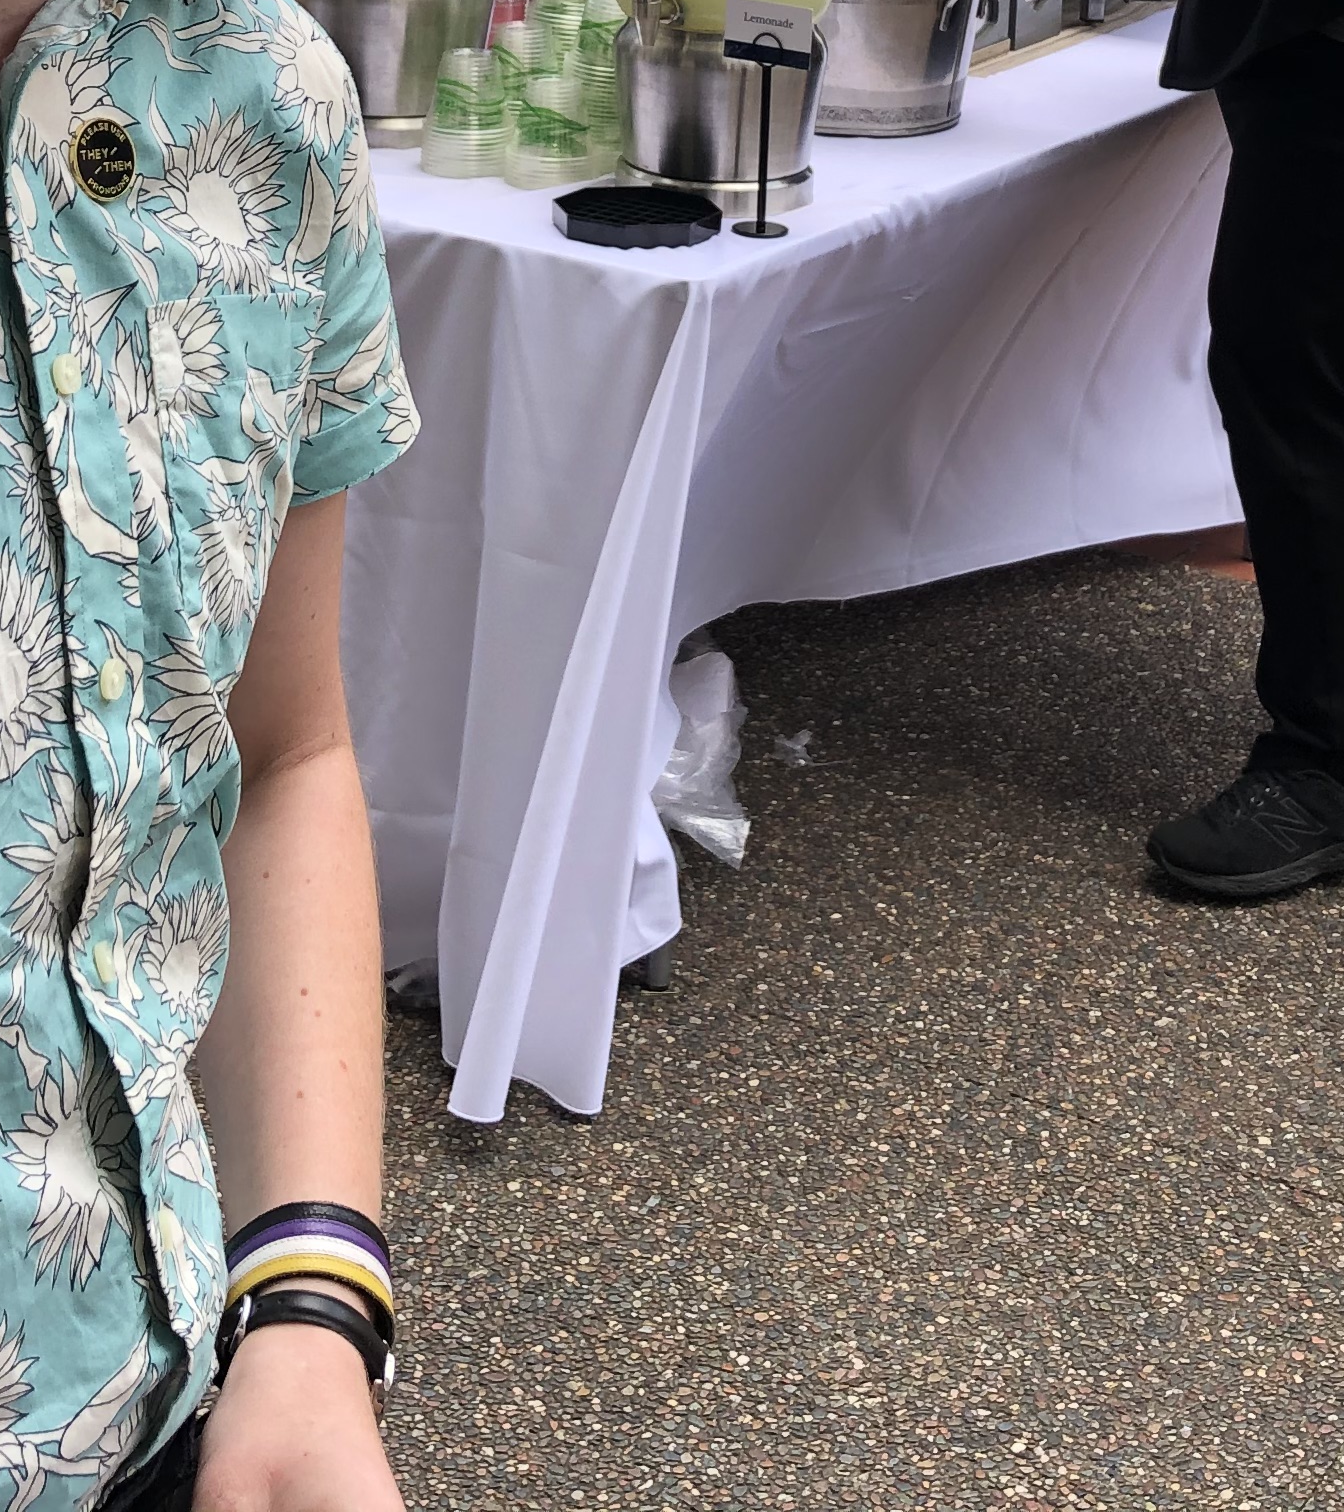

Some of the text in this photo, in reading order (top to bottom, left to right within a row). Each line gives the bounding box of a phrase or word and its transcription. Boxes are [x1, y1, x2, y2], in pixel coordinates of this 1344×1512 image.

[743, 11, 795, 30] Lemonade
[80, 122, 126, 146] PLEASE USE
[88, 174, 129, 194] PRONOUNS
